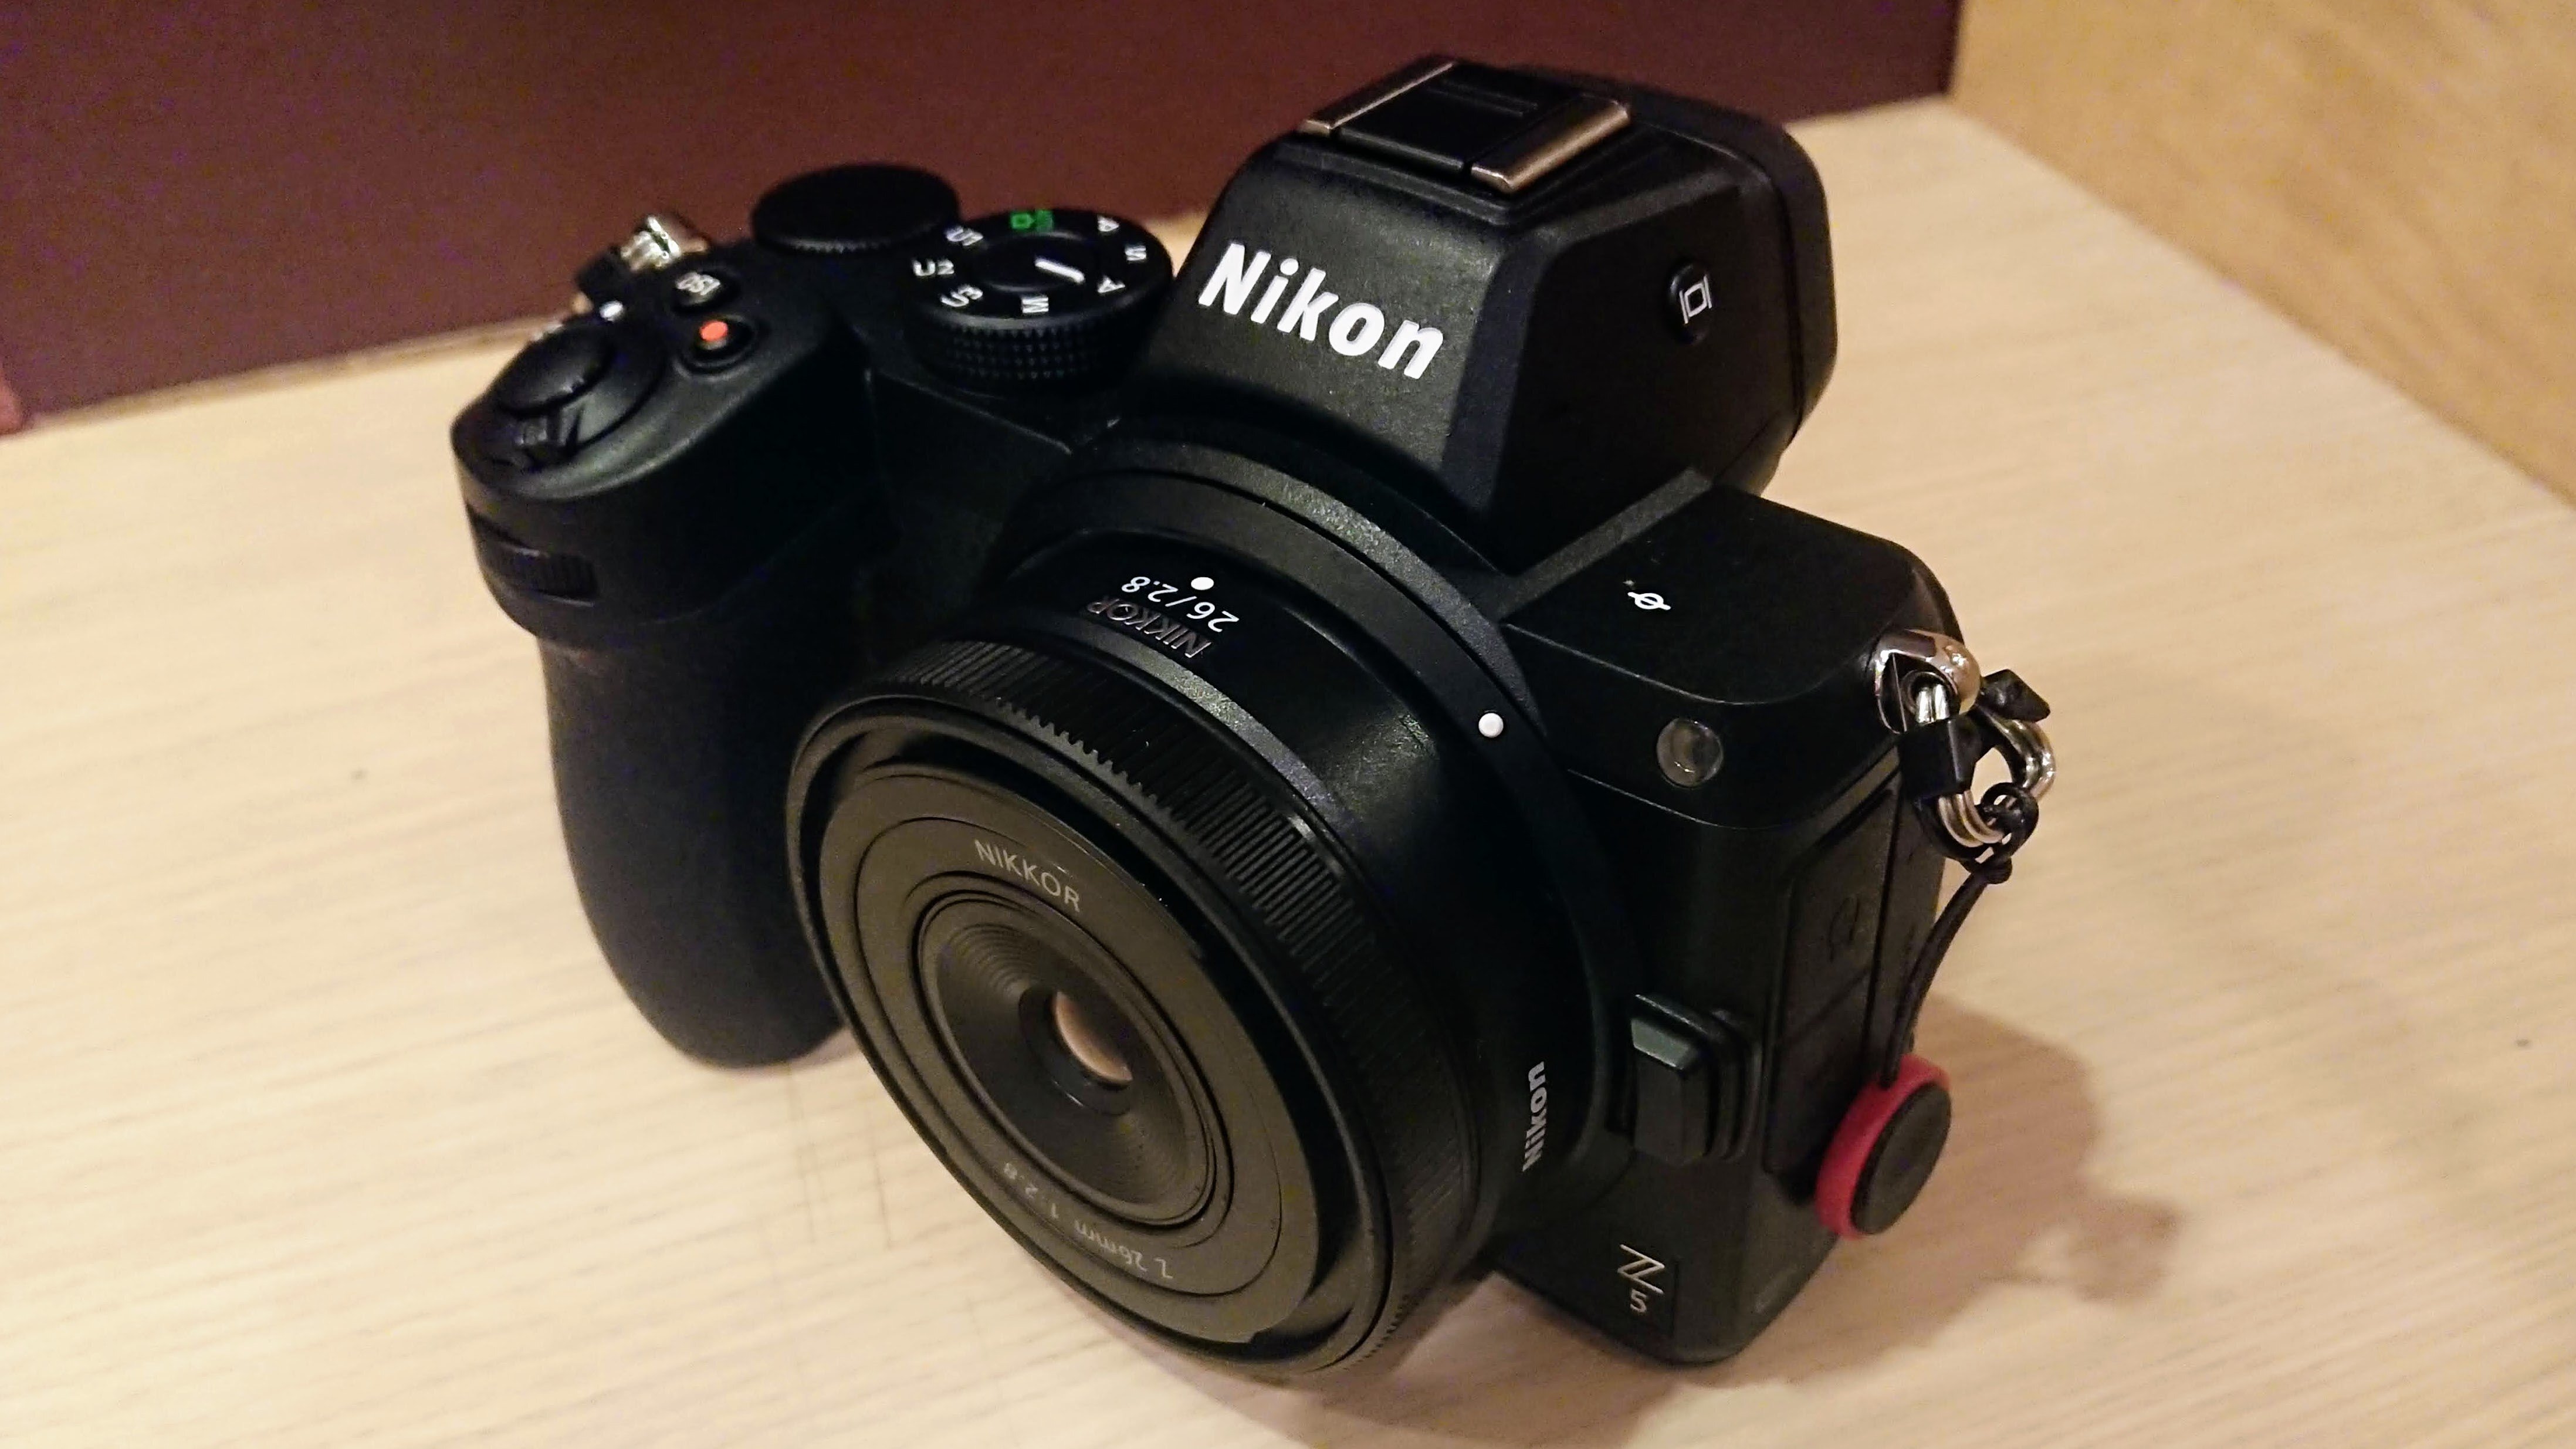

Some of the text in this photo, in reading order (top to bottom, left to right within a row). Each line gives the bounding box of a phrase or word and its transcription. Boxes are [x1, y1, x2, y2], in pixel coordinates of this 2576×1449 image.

[913, 260, 954, 276] U2
[942, 285, 983, 307] U3
[1199, 243, 1443, 379] Nikon
[1088, 599, 1211, 657] NIKKOR
[1122, 576, 1239, 632] 26/2.8
[975, 840, 1079, 912] NIKKOR
[1522, 1062, 1546, 1171] Nikon
[1075, 1221, 1146, 1272] 26mm
[1630, 1291, 1647, 1313] 5
